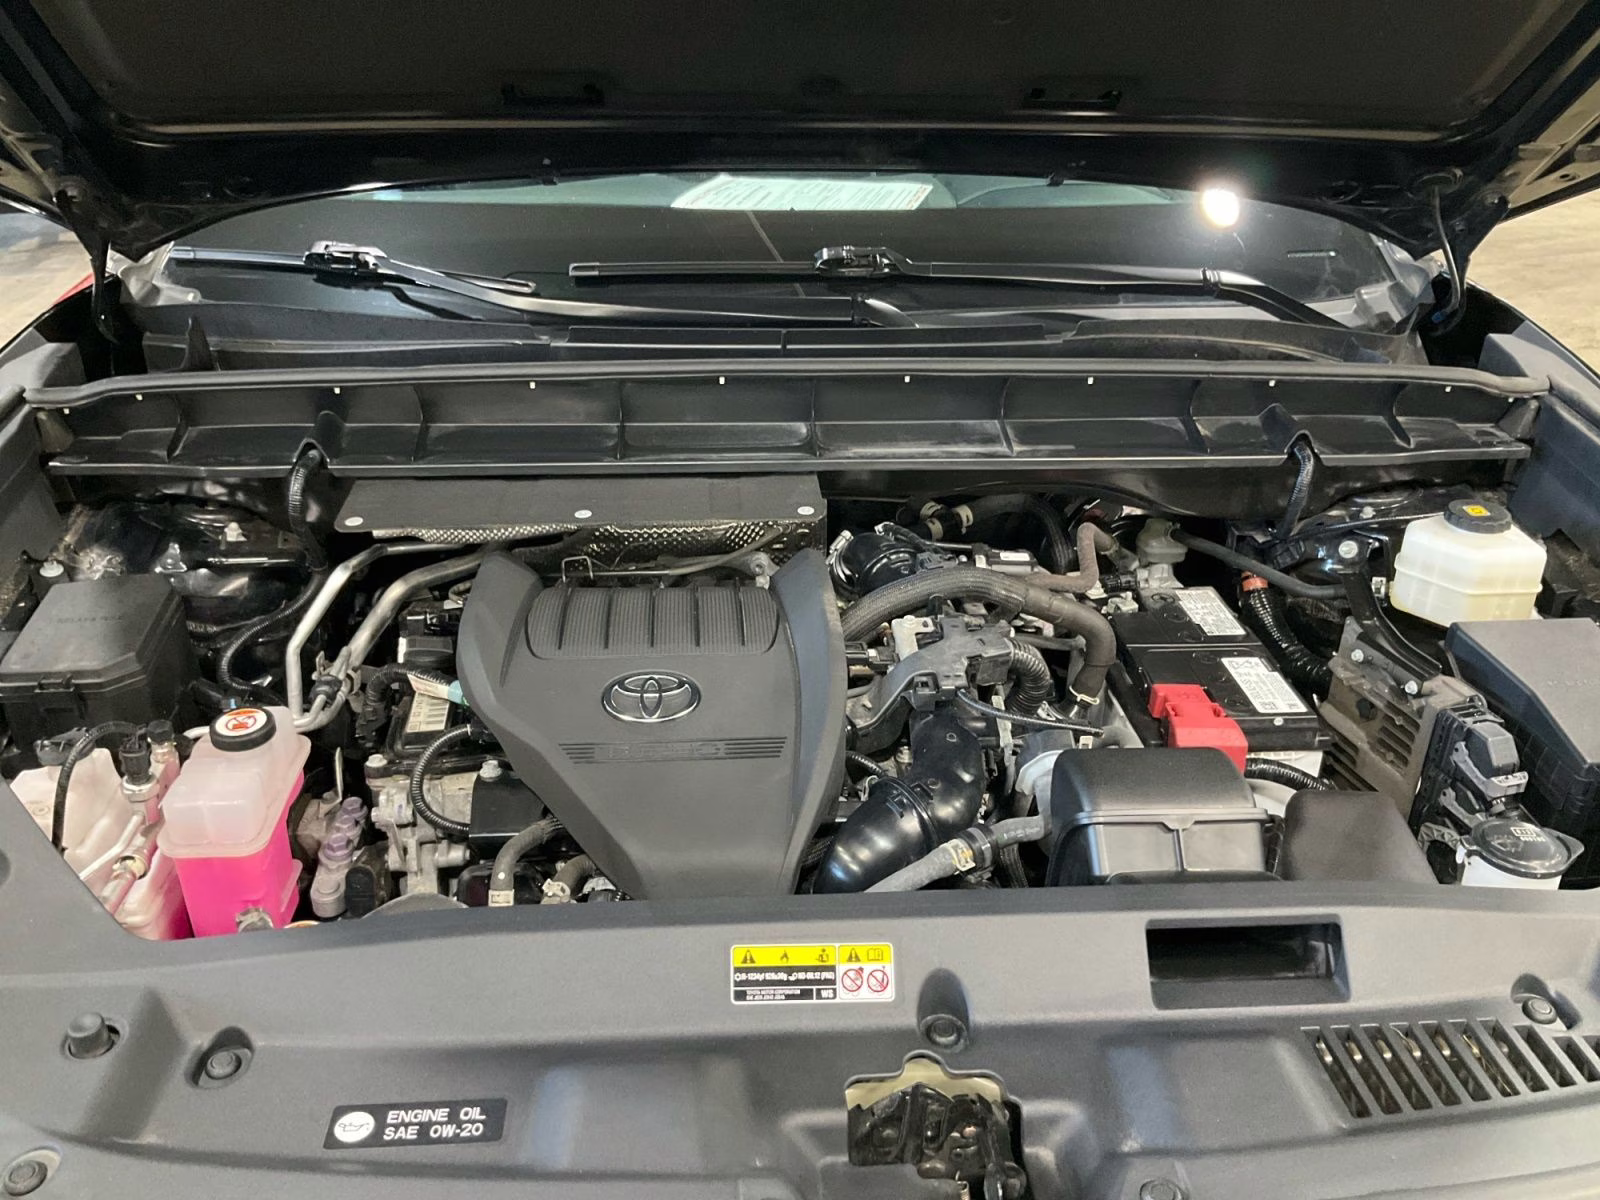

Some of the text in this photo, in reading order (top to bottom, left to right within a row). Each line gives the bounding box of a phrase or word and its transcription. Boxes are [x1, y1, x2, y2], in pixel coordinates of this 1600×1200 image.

[821, 989, 834, 998] WS
[386, 1106, 486, 1124] ENGINE OIL
[383, 1122, 484, 1140] SAE 0W-20
